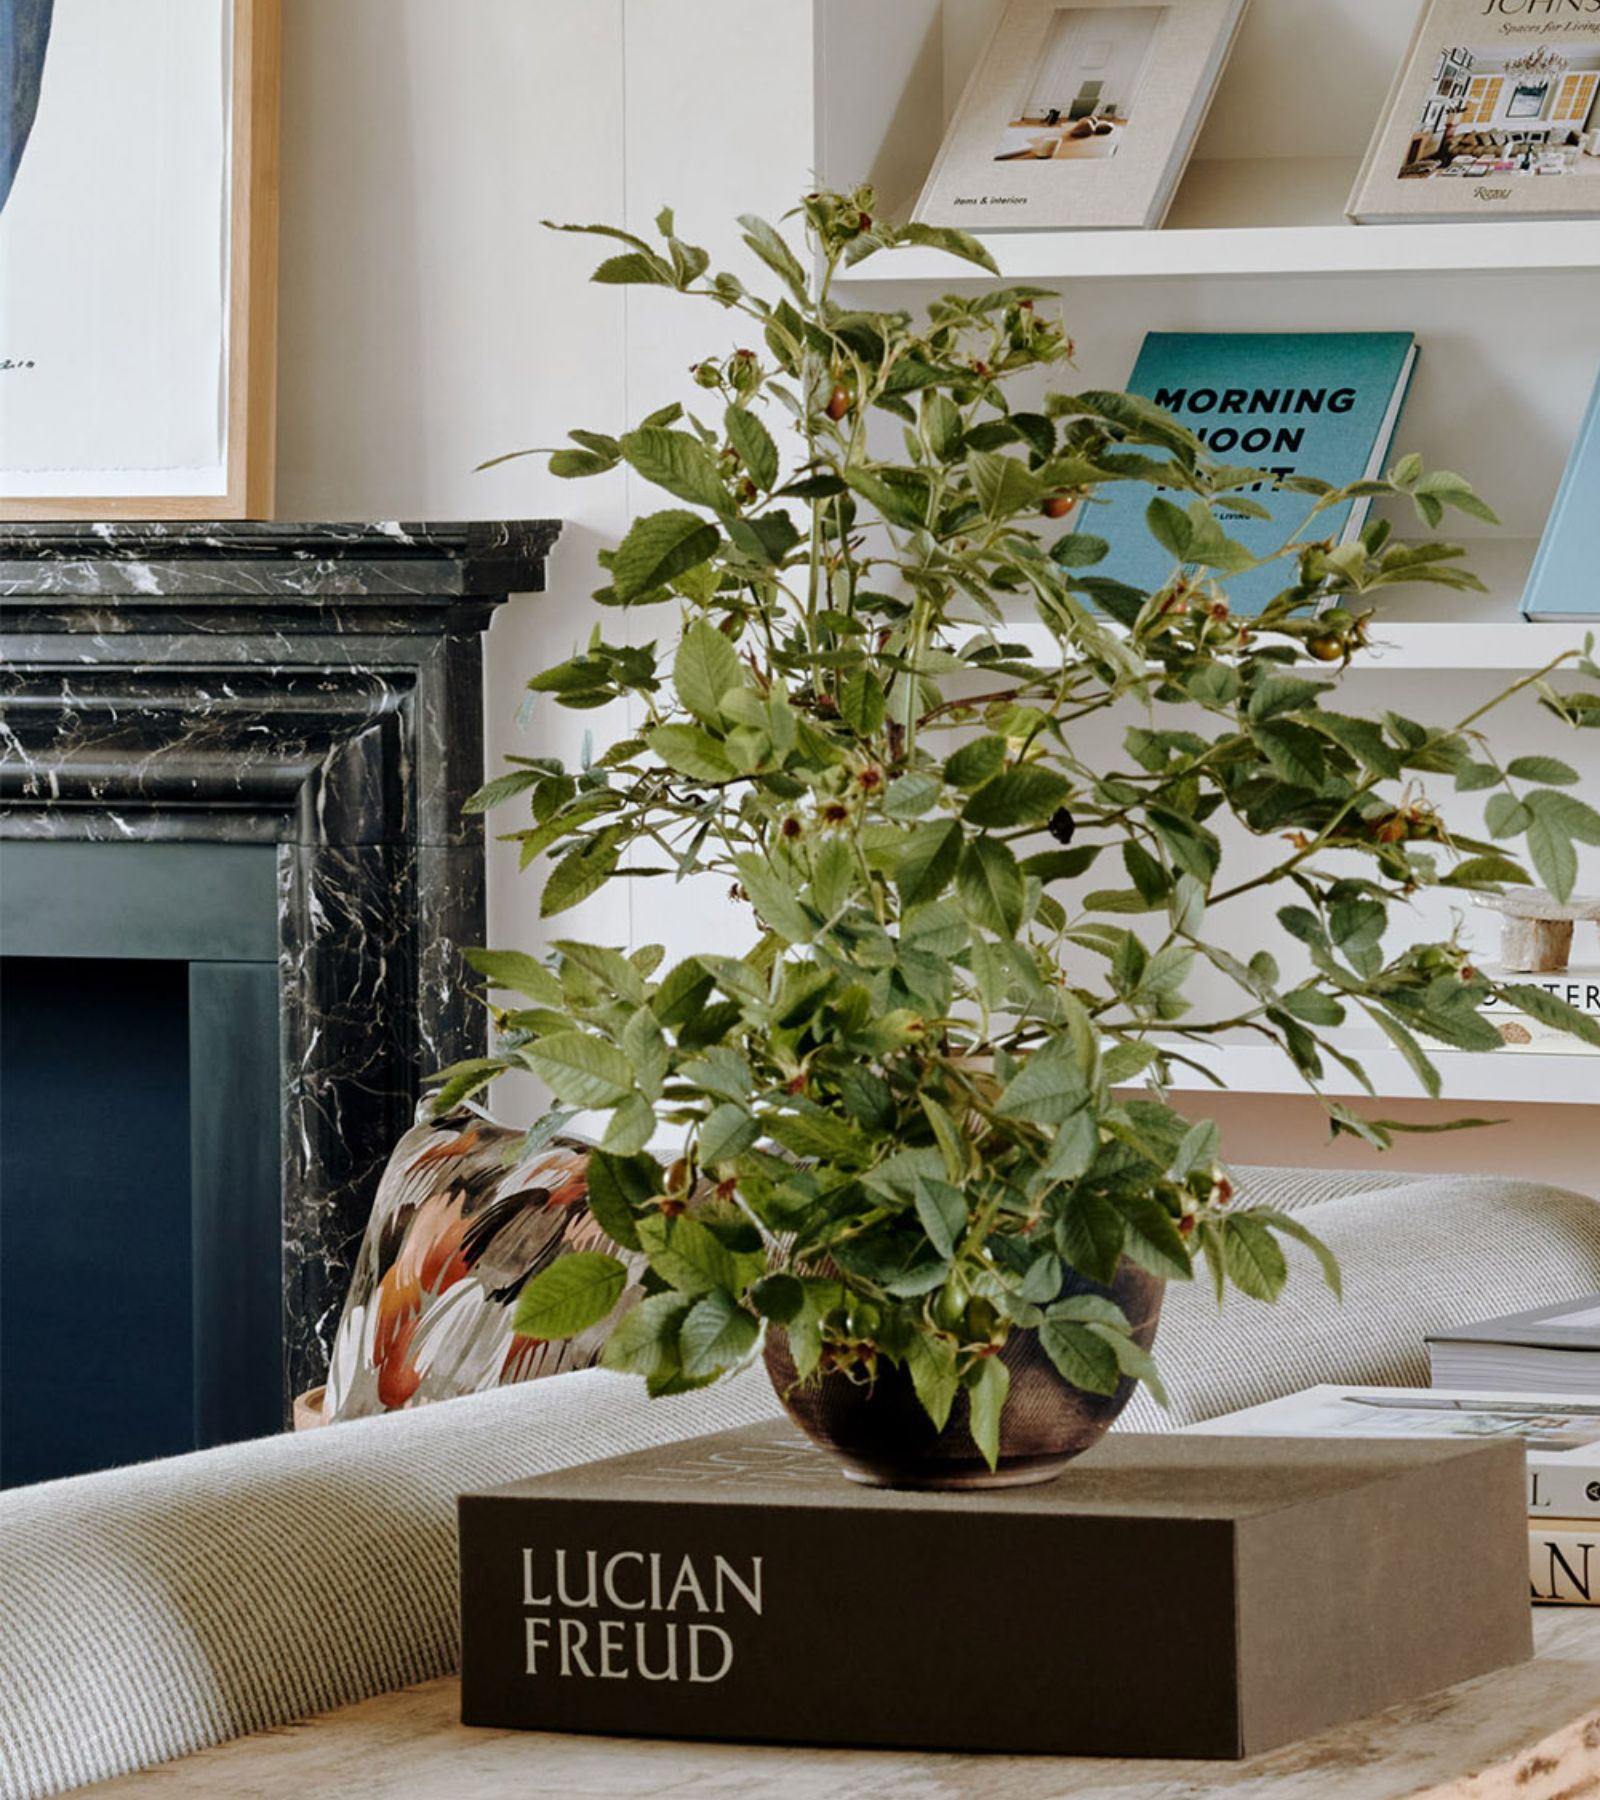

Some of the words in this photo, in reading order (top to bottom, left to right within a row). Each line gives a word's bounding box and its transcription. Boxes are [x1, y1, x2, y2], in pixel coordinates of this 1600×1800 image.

[1499, 22, 1541, 36] Spaces
[1541, 21, 1561, 35] for
[1153, 387, 1358, 414] MORNING
[522, 1547, 763, 1616] LUCIAN
[1530, 1542, 1596, 1601] N
[524, 1616, 734, 1683] FREUD
